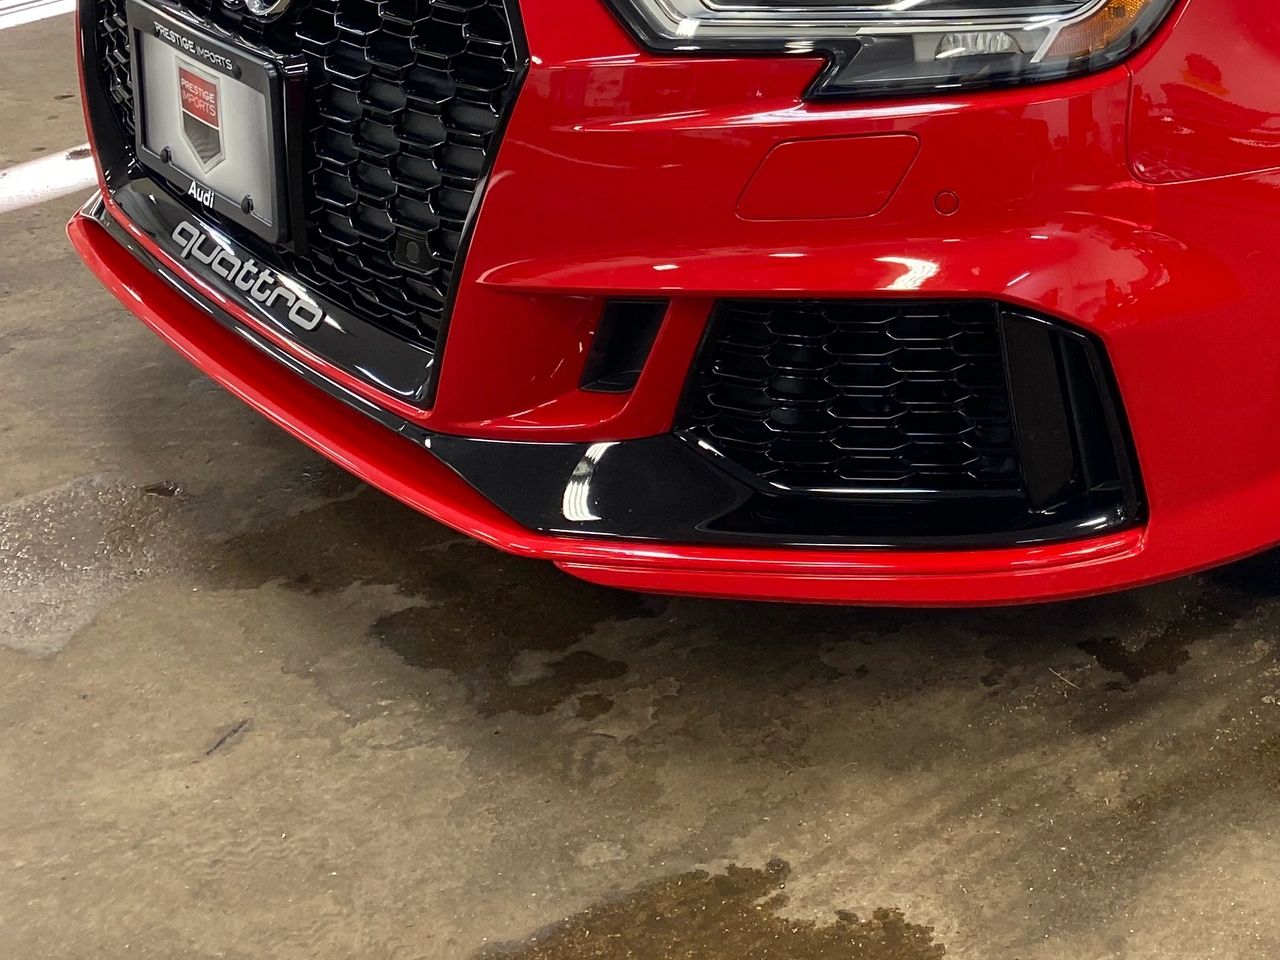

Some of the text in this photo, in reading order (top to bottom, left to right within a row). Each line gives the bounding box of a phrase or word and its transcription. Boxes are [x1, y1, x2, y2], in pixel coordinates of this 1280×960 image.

[153, 20, 233, 70] PRESTIGE IMPORTS
[180, 78, 215, 104] PRESTIGE
[181, 90, 216, 117] IMPORTS
[187, 180, 215, 209] Audi
[171, 220, 323, 331] quattro
